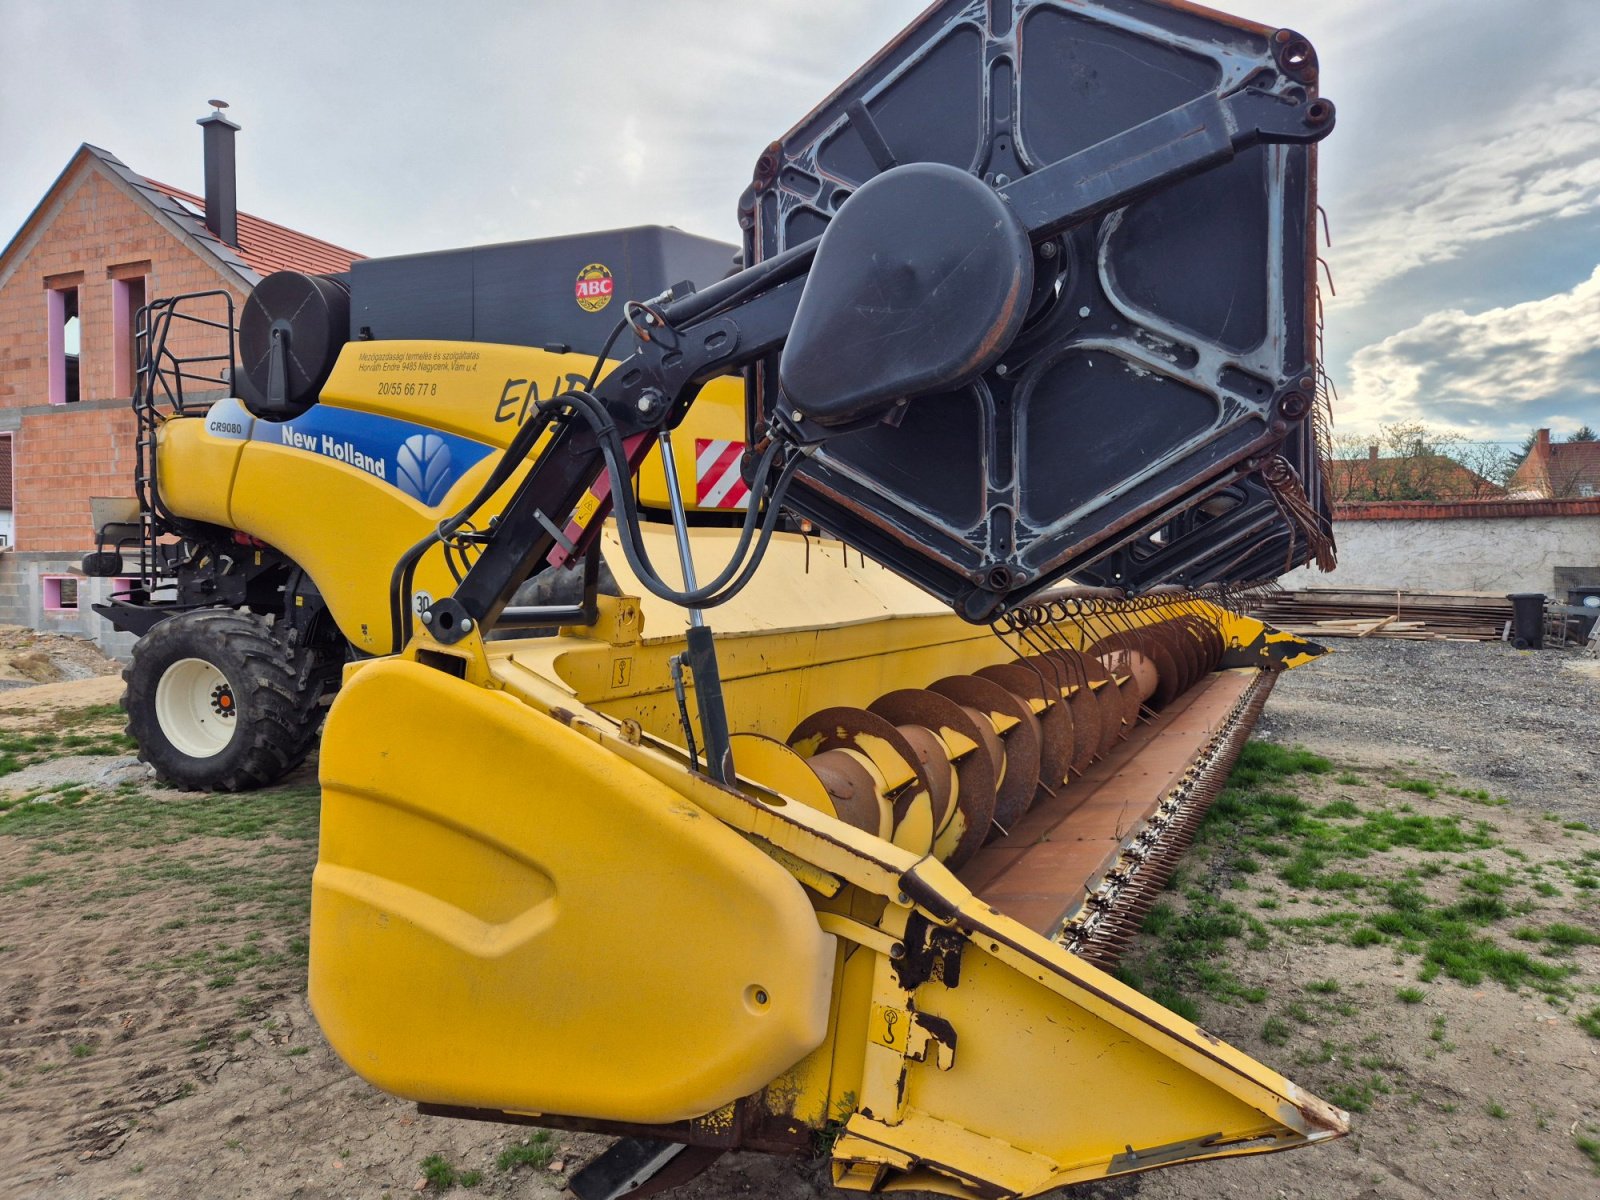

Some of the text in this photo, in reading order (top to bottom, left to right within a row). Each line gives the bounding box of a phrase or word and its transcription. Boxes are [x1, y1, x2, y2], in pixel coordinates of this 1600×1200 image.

[576, 279, 612, 297] ABC
[433, 351, 441, 361] és
[383, 362, 401, 373] Endre
[402, 361, 418, 372] 9485
[378, 382, 437, 397] 20/55 66 77 8
[210, 421, 242, 435] CR9080
[281, 424, 386, 479] New Holland
